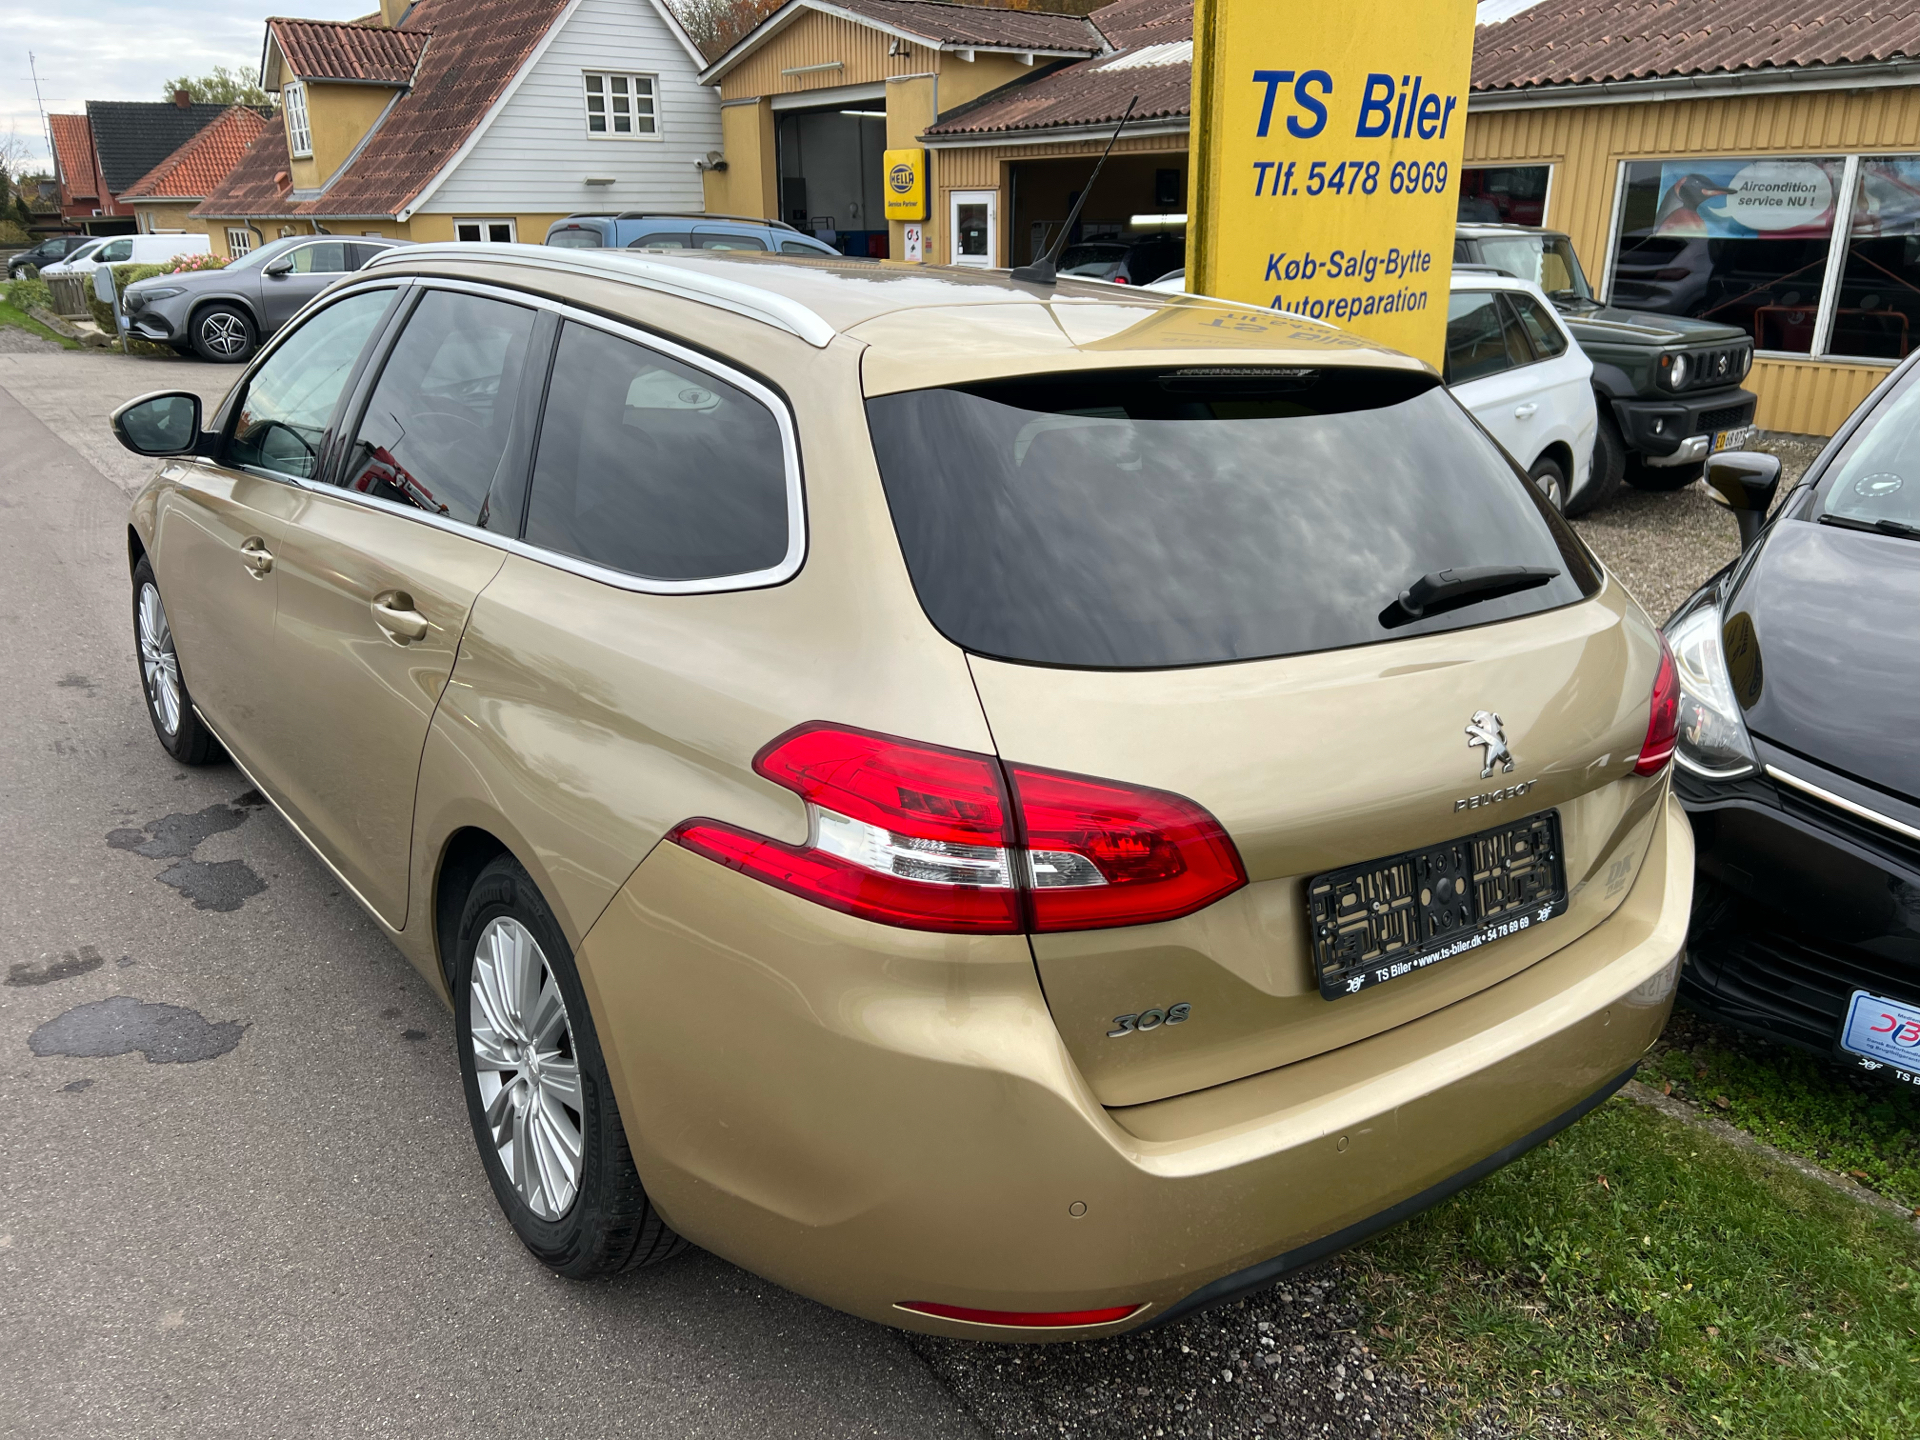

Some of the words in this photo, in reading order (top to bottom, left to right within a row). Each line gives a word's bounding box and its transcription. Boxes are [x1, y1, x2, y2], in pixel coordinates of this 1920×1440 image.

[1252, 69, 1333, 139] TS
[1355, 73, 1457, 139] Biler
[890, 170, 915, 185] HELLA
[1253, 161, 1298, 196] Tlf.
[1306, 160, 1380, 196] 5478
[1390, 160, 1448, 195] 6969
[1739, 181, 1817, 193] Aircondition
[903, 200, 918, 208] Partner
[1738, 196, 1783, 207] service
[1787, 196, 1807, 207] NU
[1264, 248, 1431, 283] Køb-Salg-Bytte
[1454, 778, 1538, 813] PEUGEOT
[1376, 968, 1390, 982] TS
[1391, 961, 1412, 978] Biler
[1418, 934, 1482, 967] www.ts-biler.dk
[1487, 928, 1498, 942] 54
[1498, 924, 1508, 937] 78
[1509, 920, 1519, 933] 69
[1519, 916, 1530, 929] 69
[1106, 1002, 1192, 1038] 308
[1895, 1070, 1911, 1082] TS
